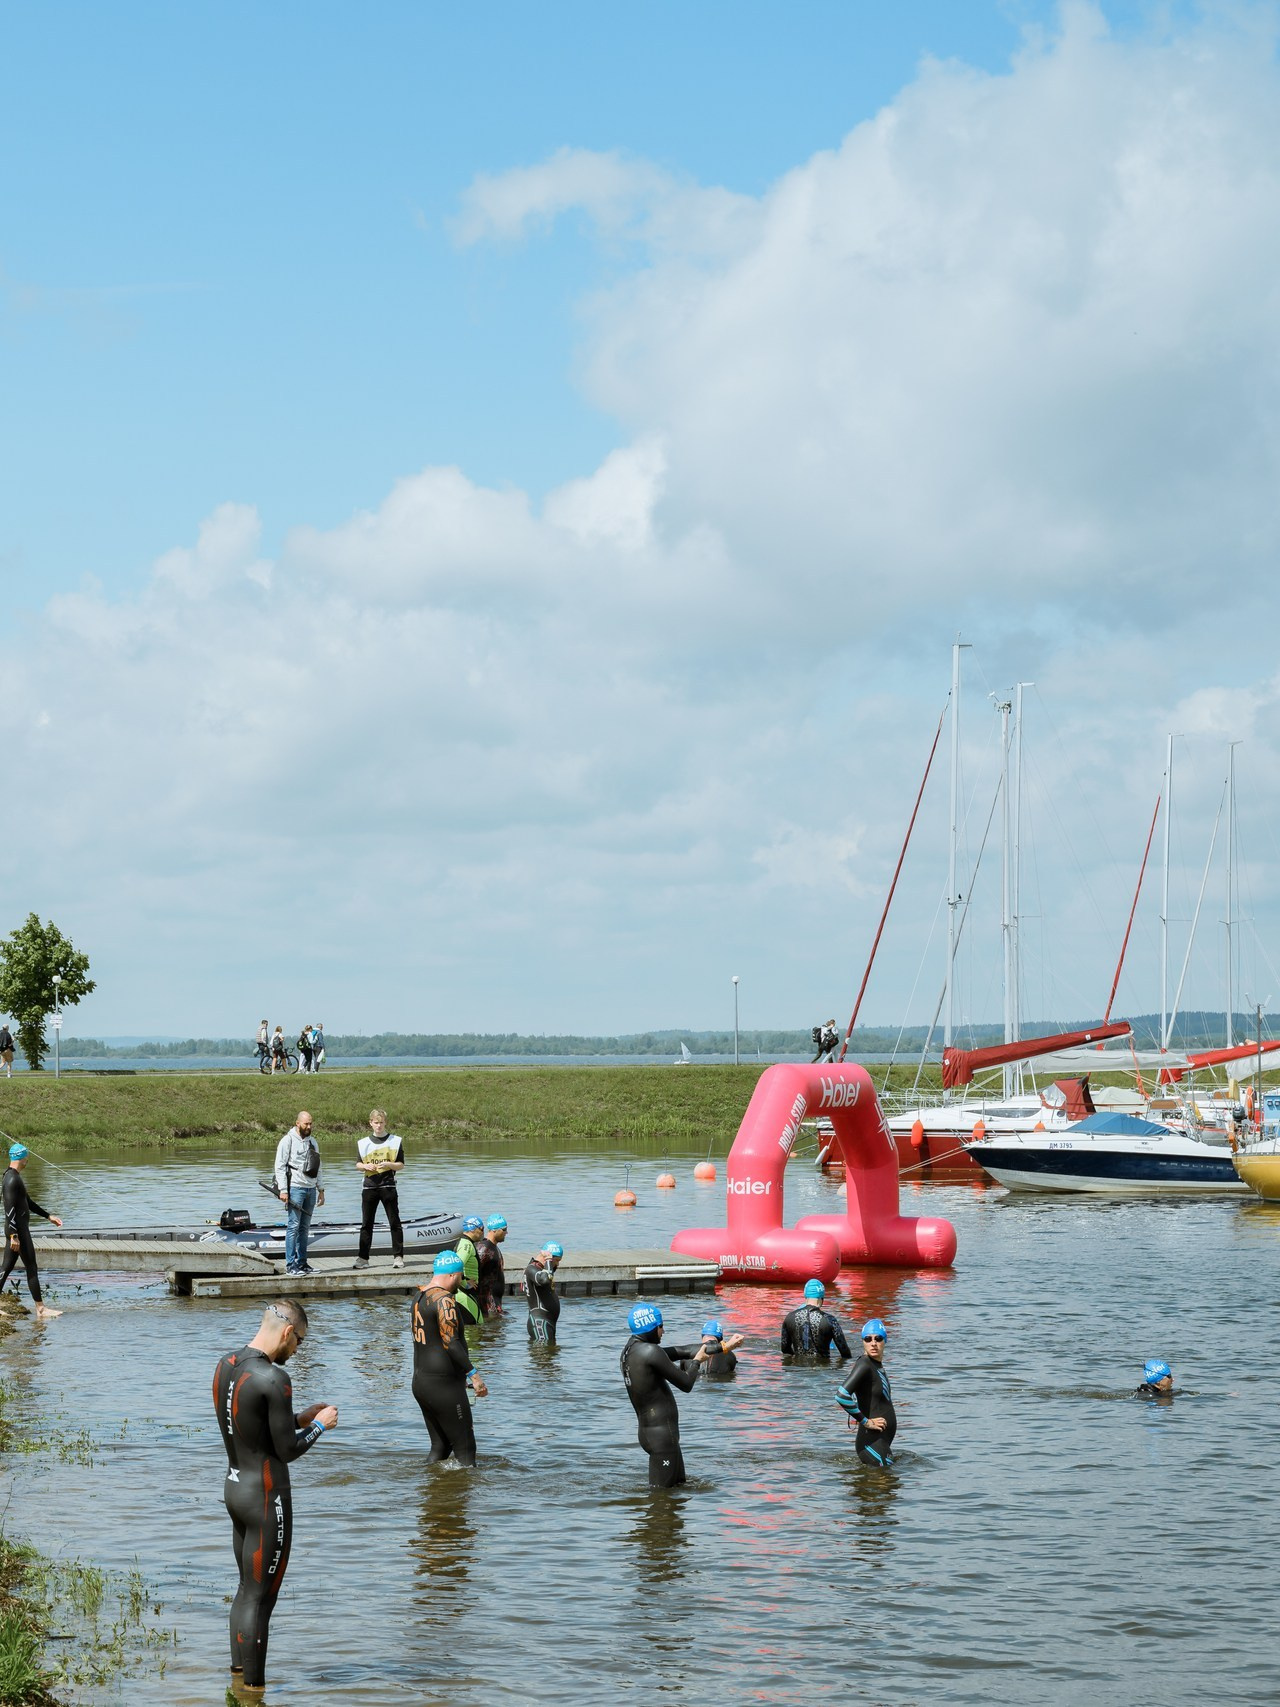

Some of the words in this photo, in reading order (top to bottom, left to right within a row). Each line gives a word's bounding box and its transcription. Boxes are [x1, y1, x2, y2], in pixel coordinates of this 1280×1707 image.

[819, 1074, 861, 1108] Haier
[778, 1123, 795, 1154] IRON
[790, 1093, 807, 1123] STAR
[726, 1176, 772, 1195] Haier
[416, 1226, 453, 1238] AM0179
[720, 1255, 738, 1266] IRON
[746, 1255, 766, 1267] STAR
[633, 1313, 656, 1329] STAR
[268, 1550, 282, 1574] PRO
